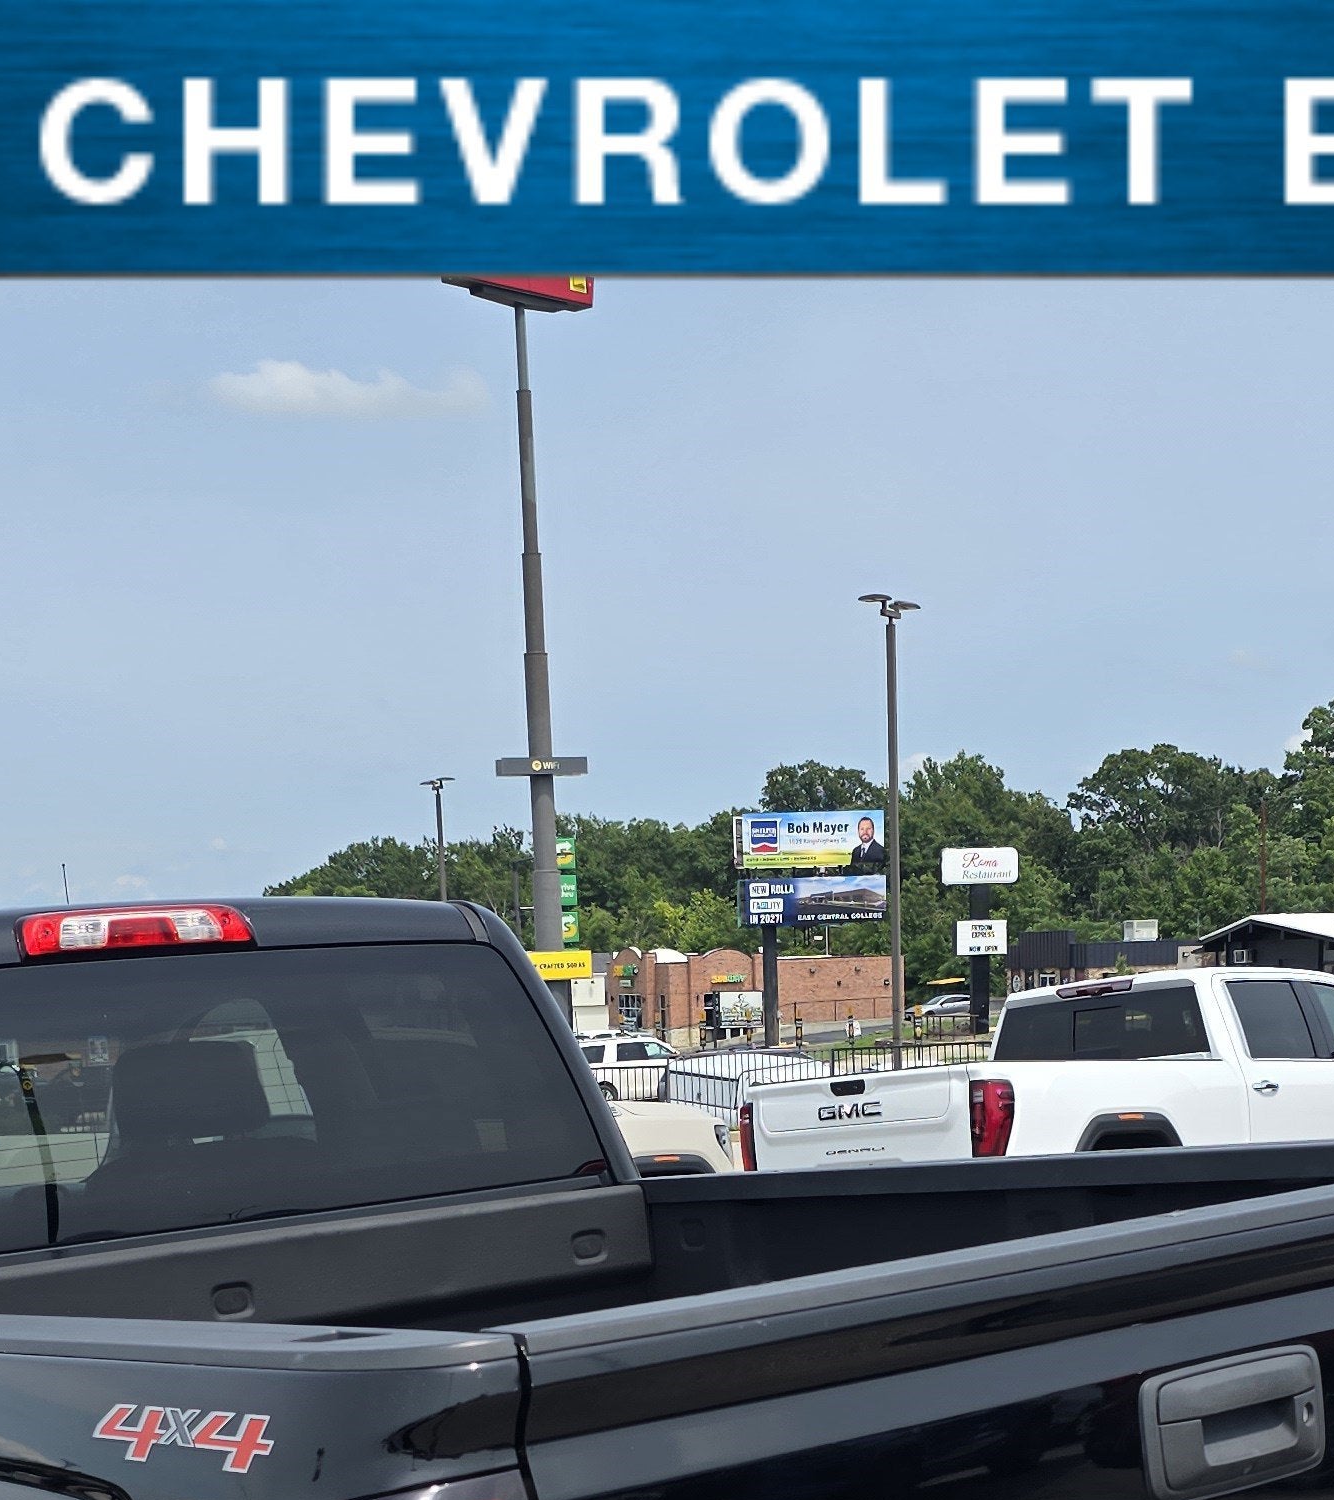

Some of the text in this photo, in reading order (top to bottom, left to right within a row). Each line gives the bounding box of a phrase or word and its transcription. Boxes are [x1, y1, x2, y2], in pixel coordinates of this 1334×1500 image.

[787, 821, 850, 836] Bob Mayer
[962, 852, 999, 869] Roma
[962, 870, 1011, 880] Restaurant
[752, 884, 795, 895] NEW ROLLA
[817, 1101, 882, 1121] GMC
